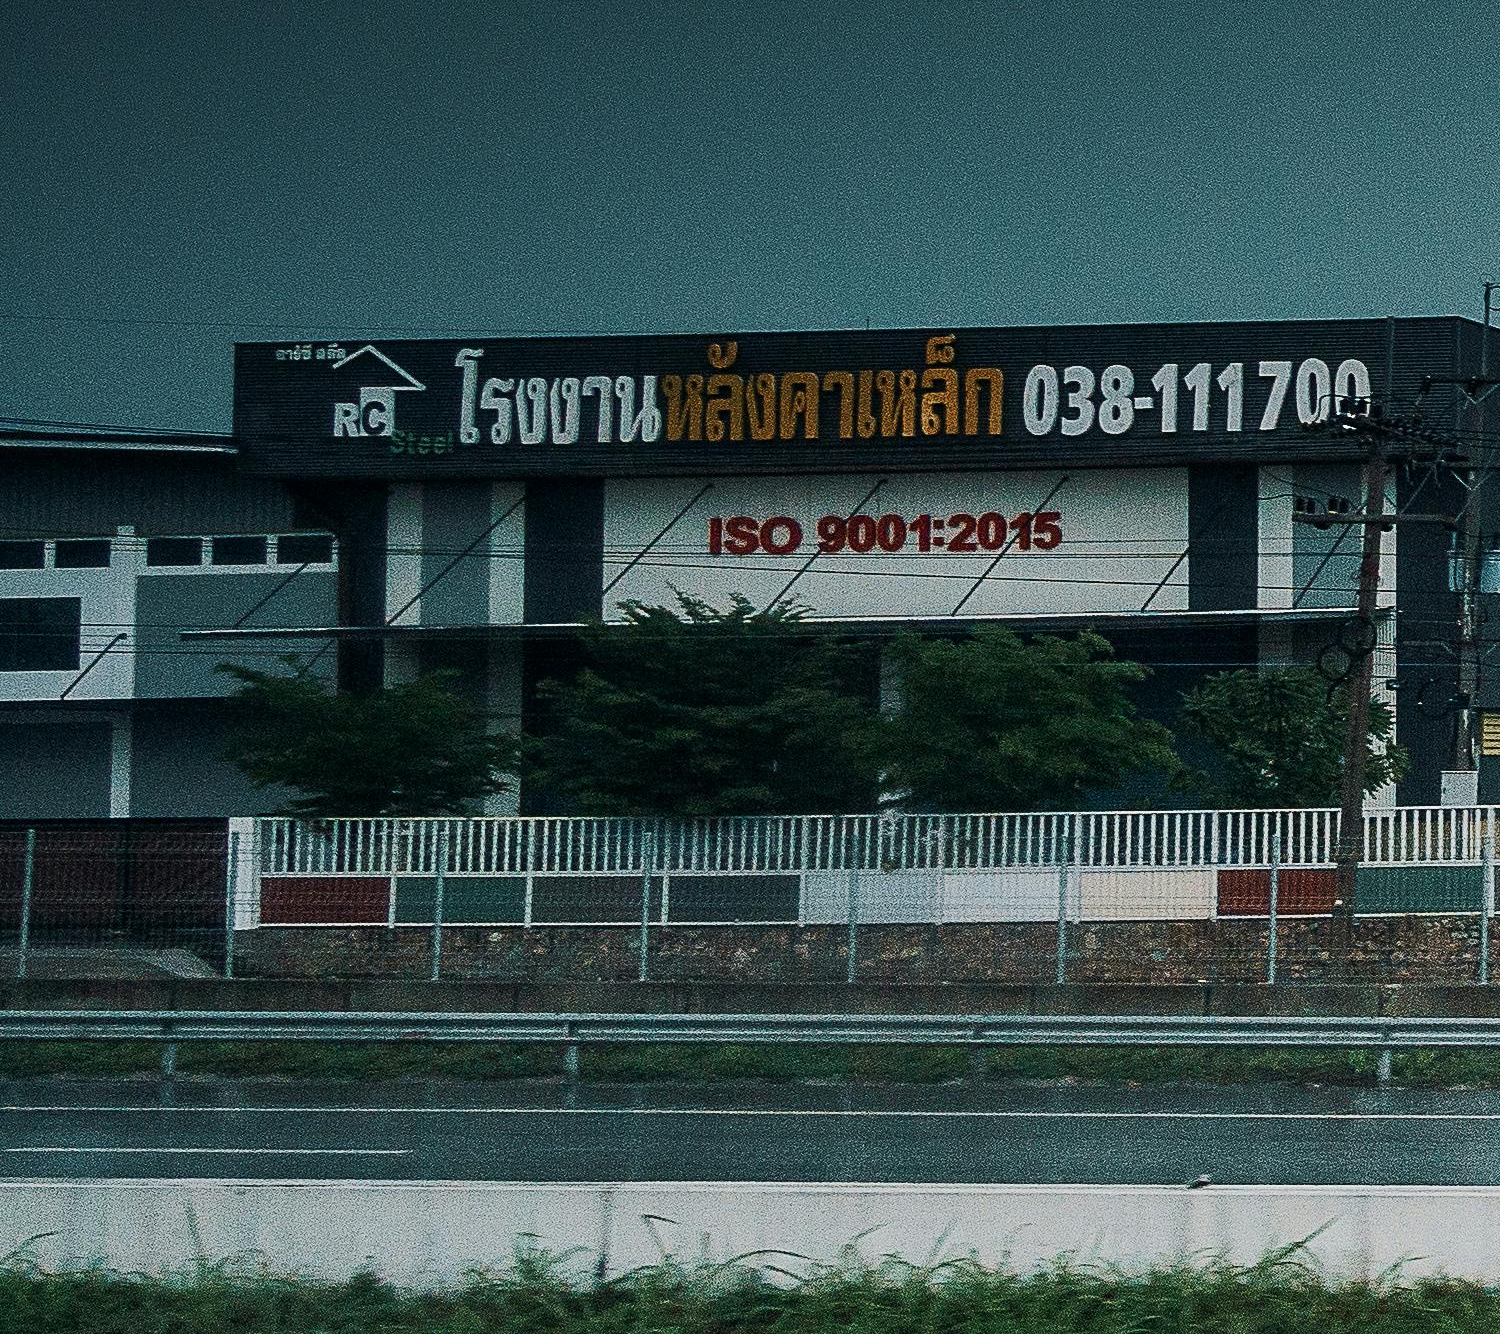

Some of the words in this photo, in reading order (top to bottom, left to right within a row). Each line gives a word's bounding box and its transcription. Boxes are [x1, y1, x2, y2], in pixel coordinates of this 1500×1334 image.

[333, 400, 394, 437] RC
[389, 428, 453, 455] Steel
[707, 514, 803, 555] ISO
[816, 511, 1063, 554] 9001:2015
